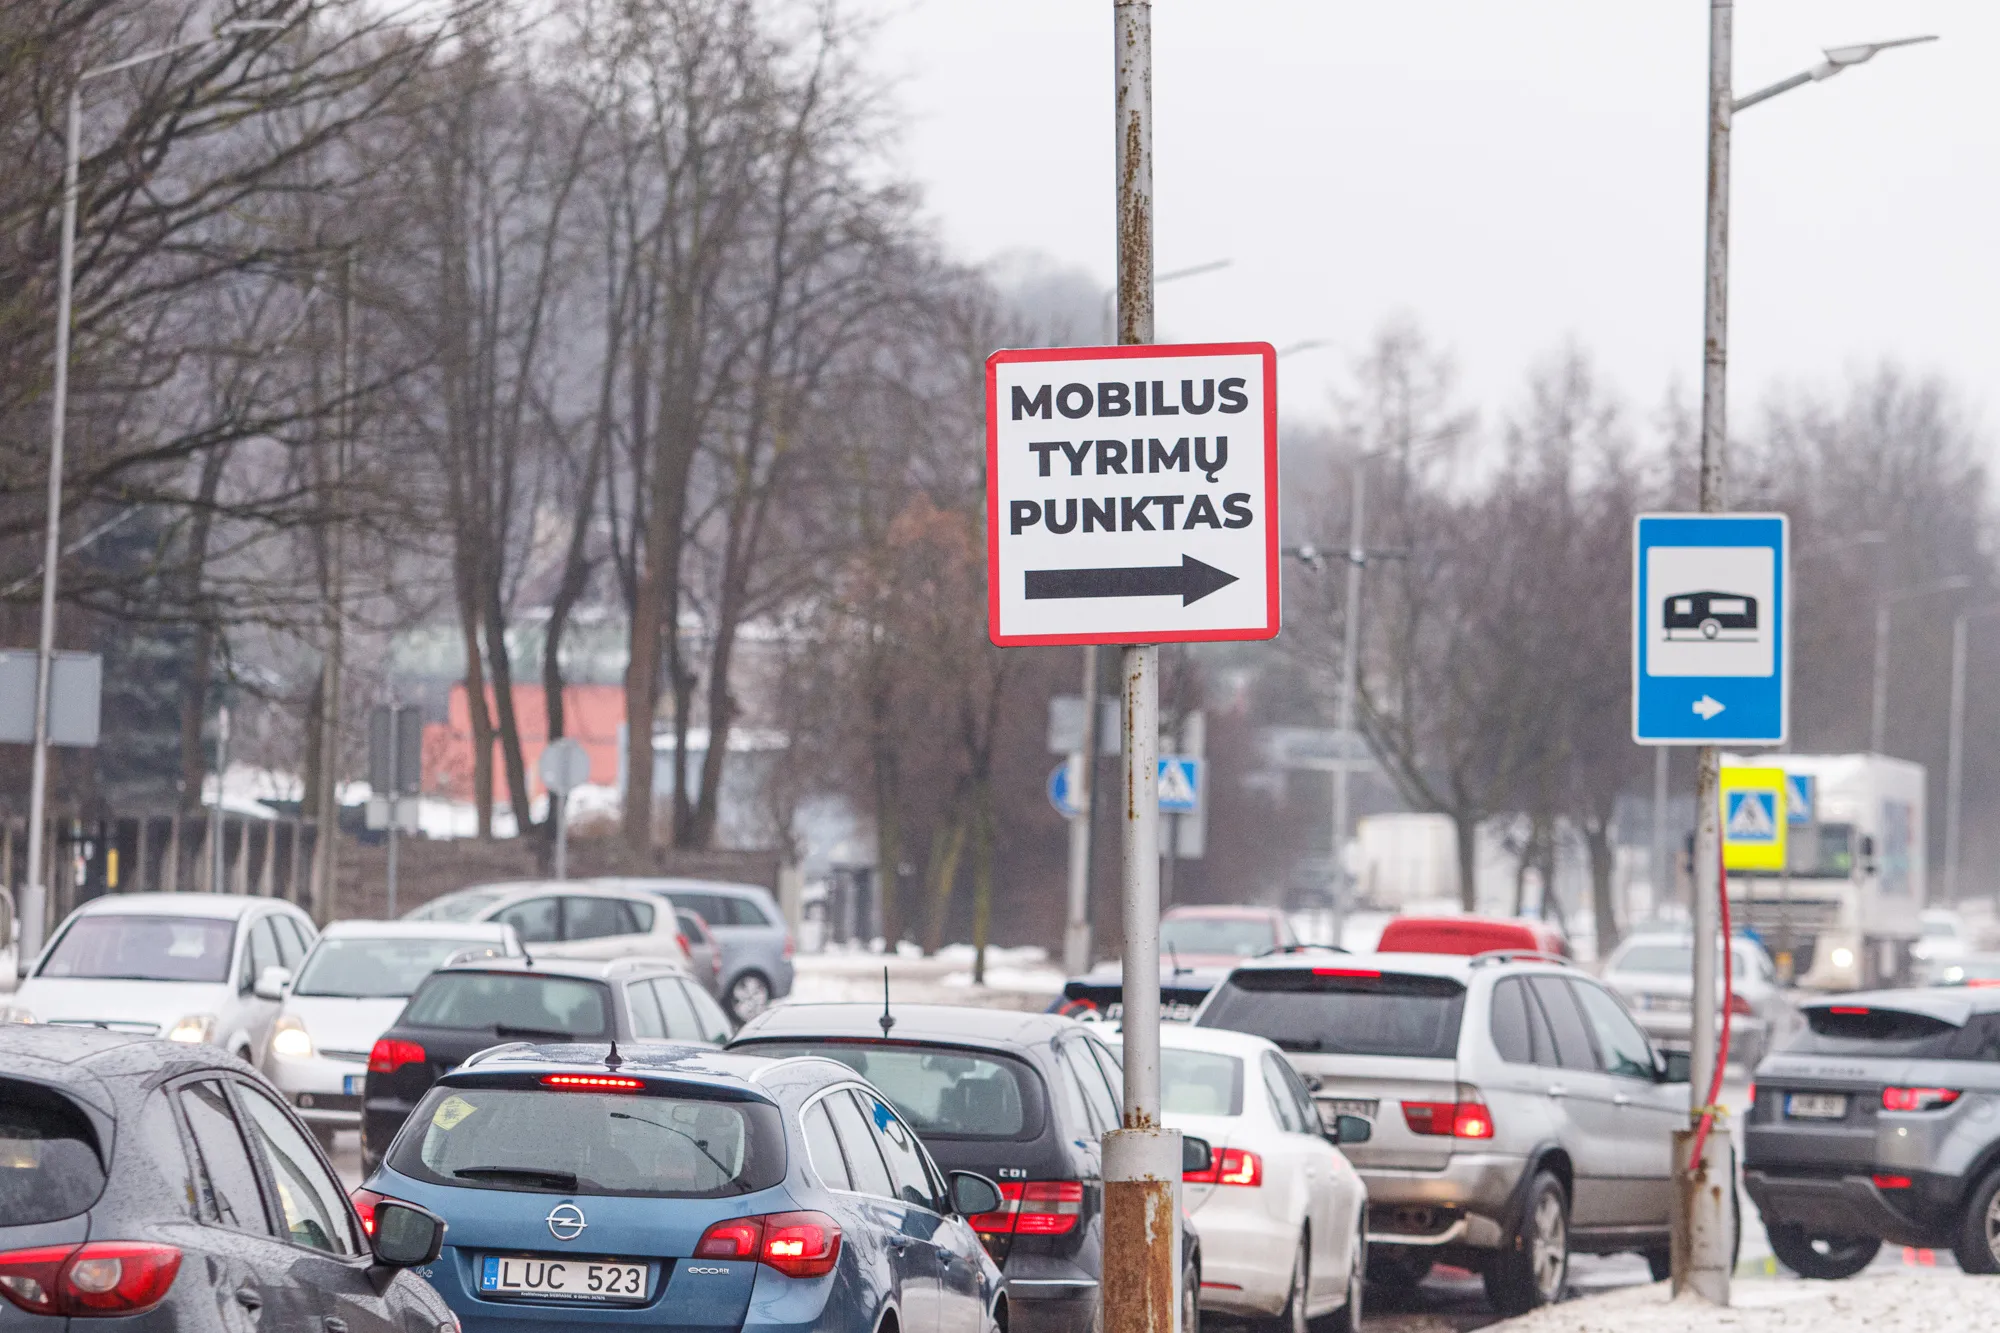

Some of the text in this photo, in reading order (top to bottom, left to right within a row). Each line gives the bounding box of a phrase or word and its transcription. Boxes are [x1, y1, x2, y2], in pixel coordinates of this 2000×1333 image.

[1011, 377, 1249, 421] MOBILUS
[1029, 436, 1229, 483] TYRIMŲ
[1010, 492, 1254, 535] PUNKTAS
[998, 1167, 1027, 1178] CDI
[484, 1277, 497, 1285] LT
[502, 1261, 641, 1294] LUC 523
